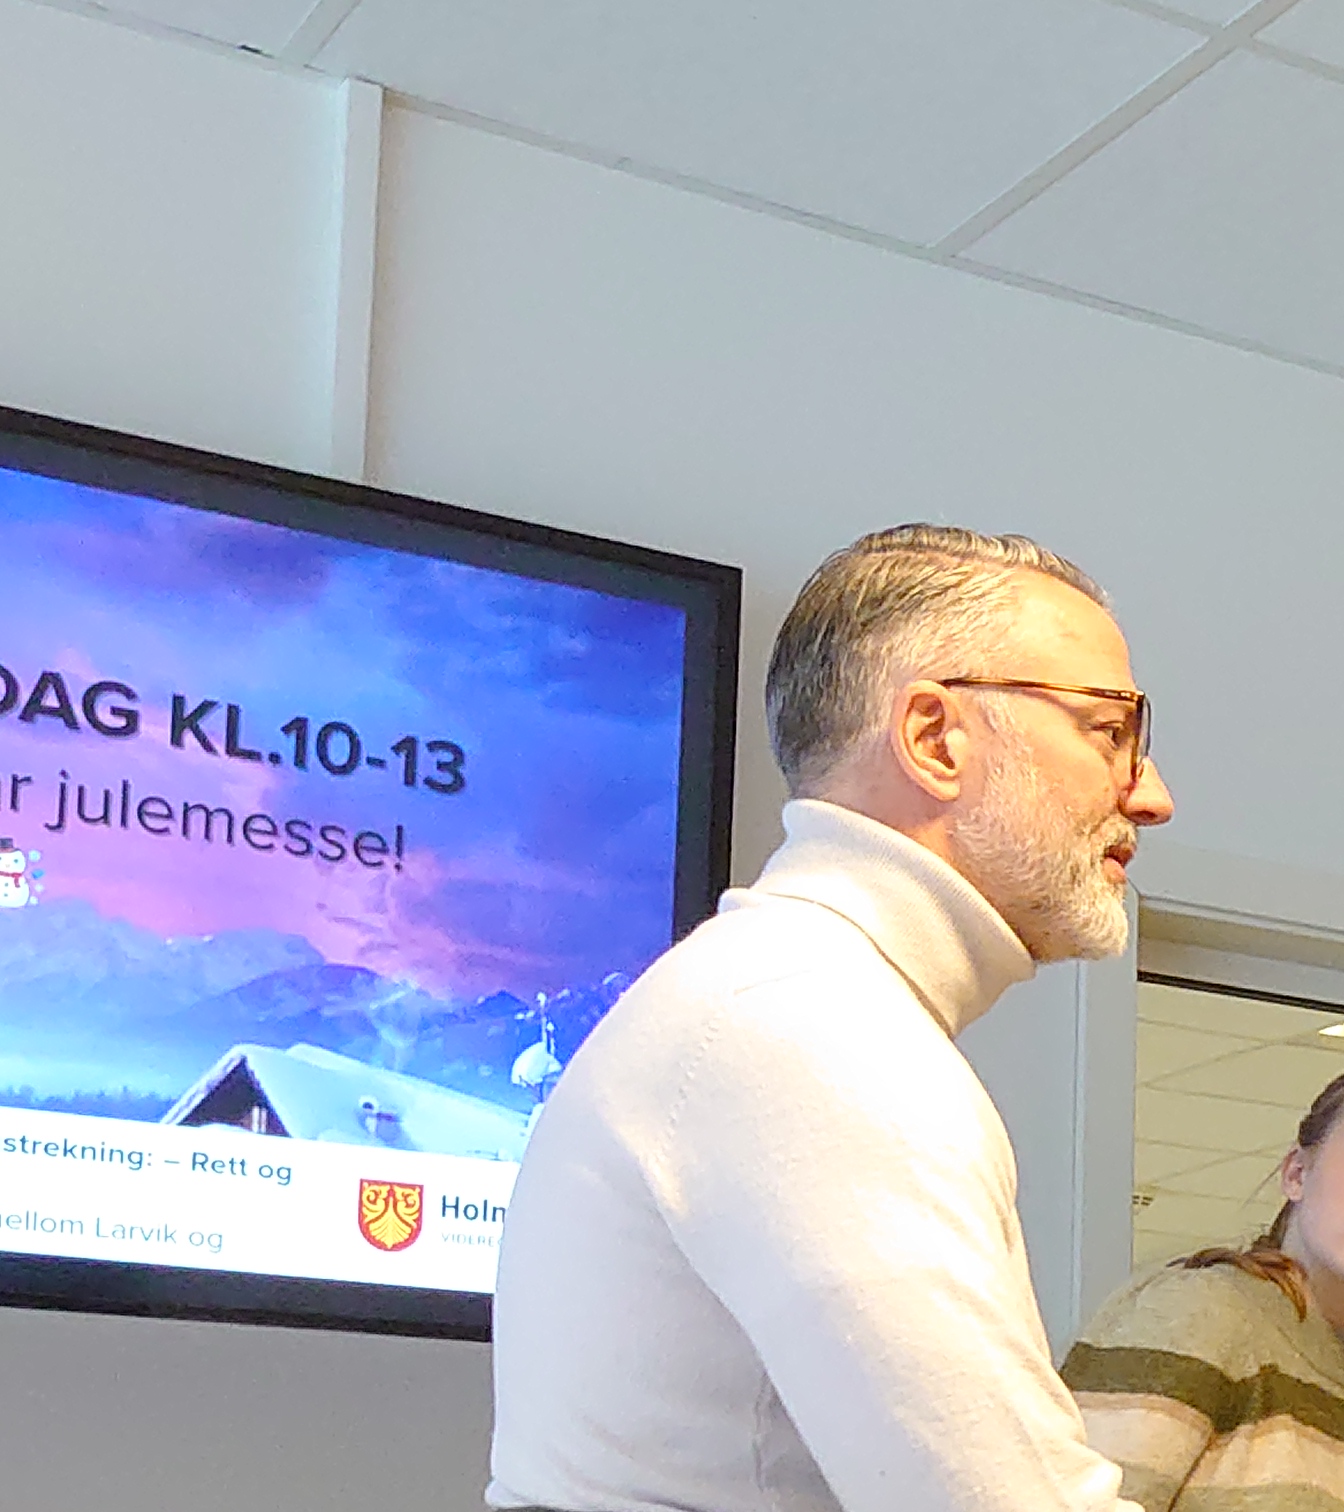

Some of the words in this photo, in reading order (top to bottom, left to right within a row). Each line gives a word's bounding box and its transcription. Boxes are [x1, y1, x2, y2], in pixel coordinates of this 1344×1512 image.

[169, 693, 466, 794] KL.10-13
[0, 773, 34, 813] r
[43, 768, 404, 873] julemesse!
[2, 1134, 153, 1171] strekning:
[191, 1151, 248, 1177] Rett
[257, 1163, 293, 1186] og
[0, 1209, 85, 1236] ellom
[95, 1216, 178, 1244] Larvik
[188, 1230, 224, 1254] og
